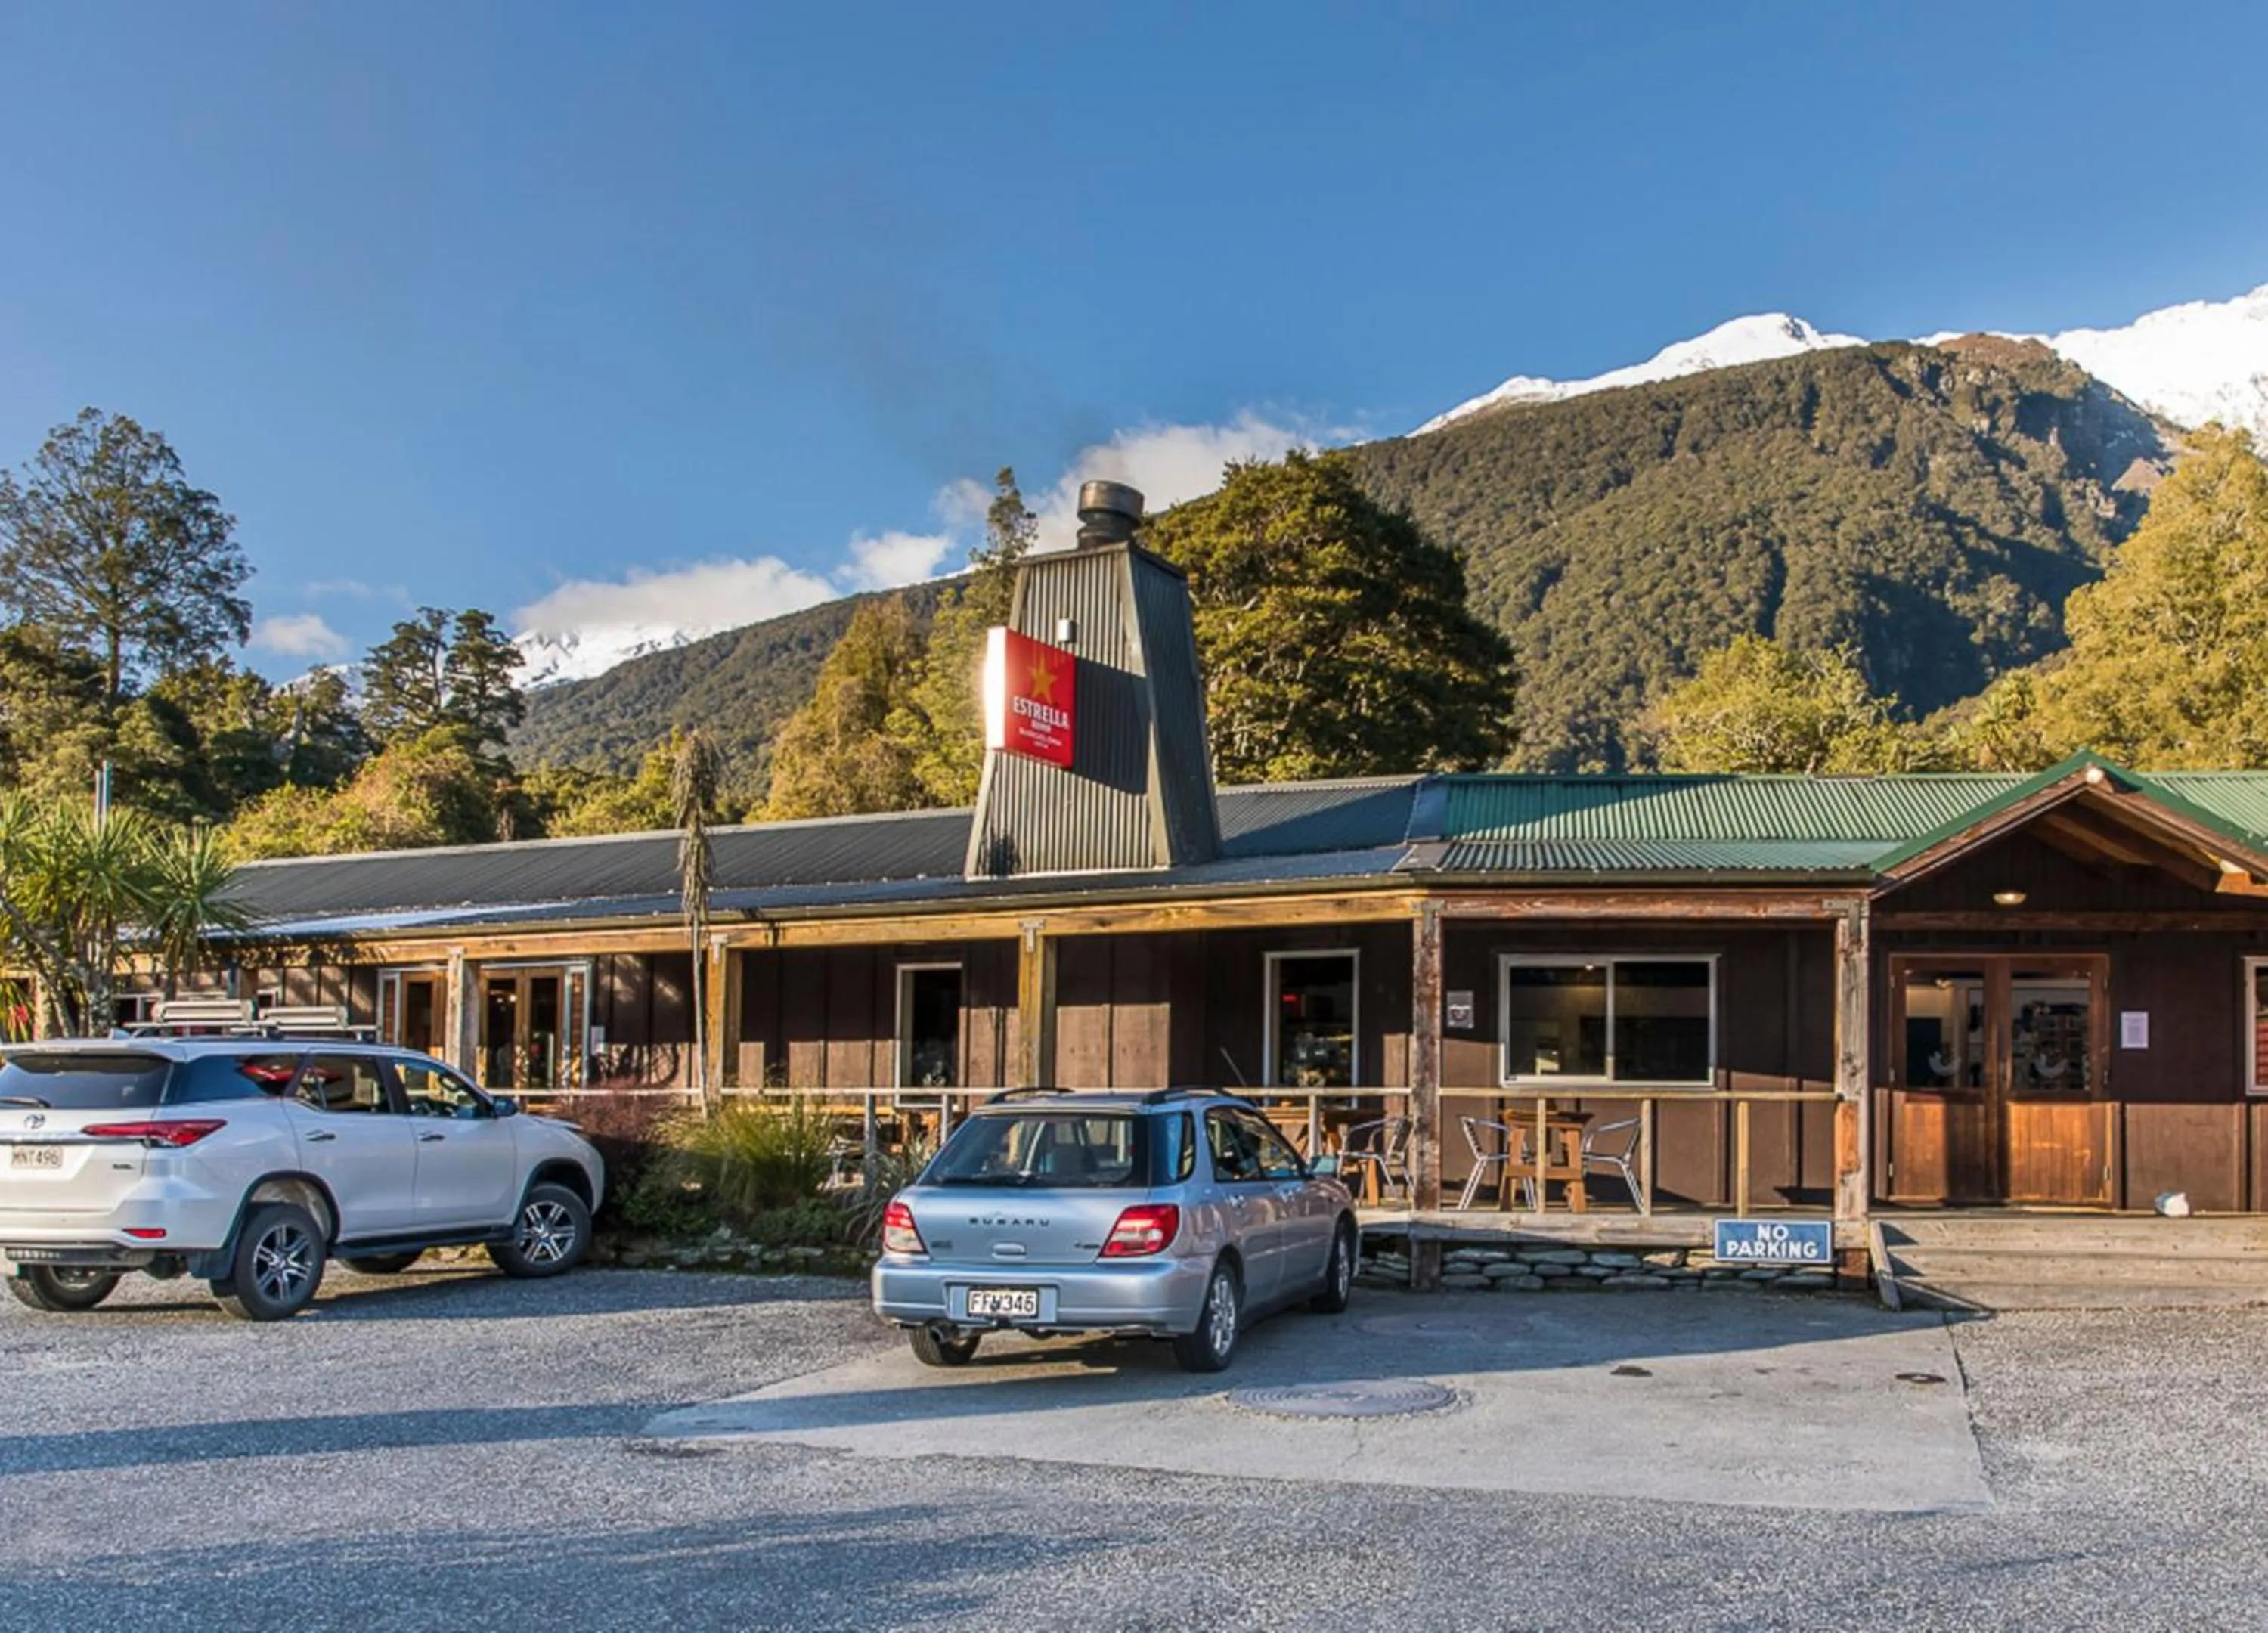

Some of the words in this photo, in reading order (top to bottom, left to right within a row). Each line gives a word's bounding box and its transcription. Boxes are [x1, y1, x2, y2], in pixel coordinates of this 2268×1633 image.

[1013, 696, 1070, 730] ESTRELLA
[969, 1217, 1050, 1227] SUBARU
[1757, 1223, 1789, 1241] NO
[1726, 1241, 1819, 1259] PARKING
